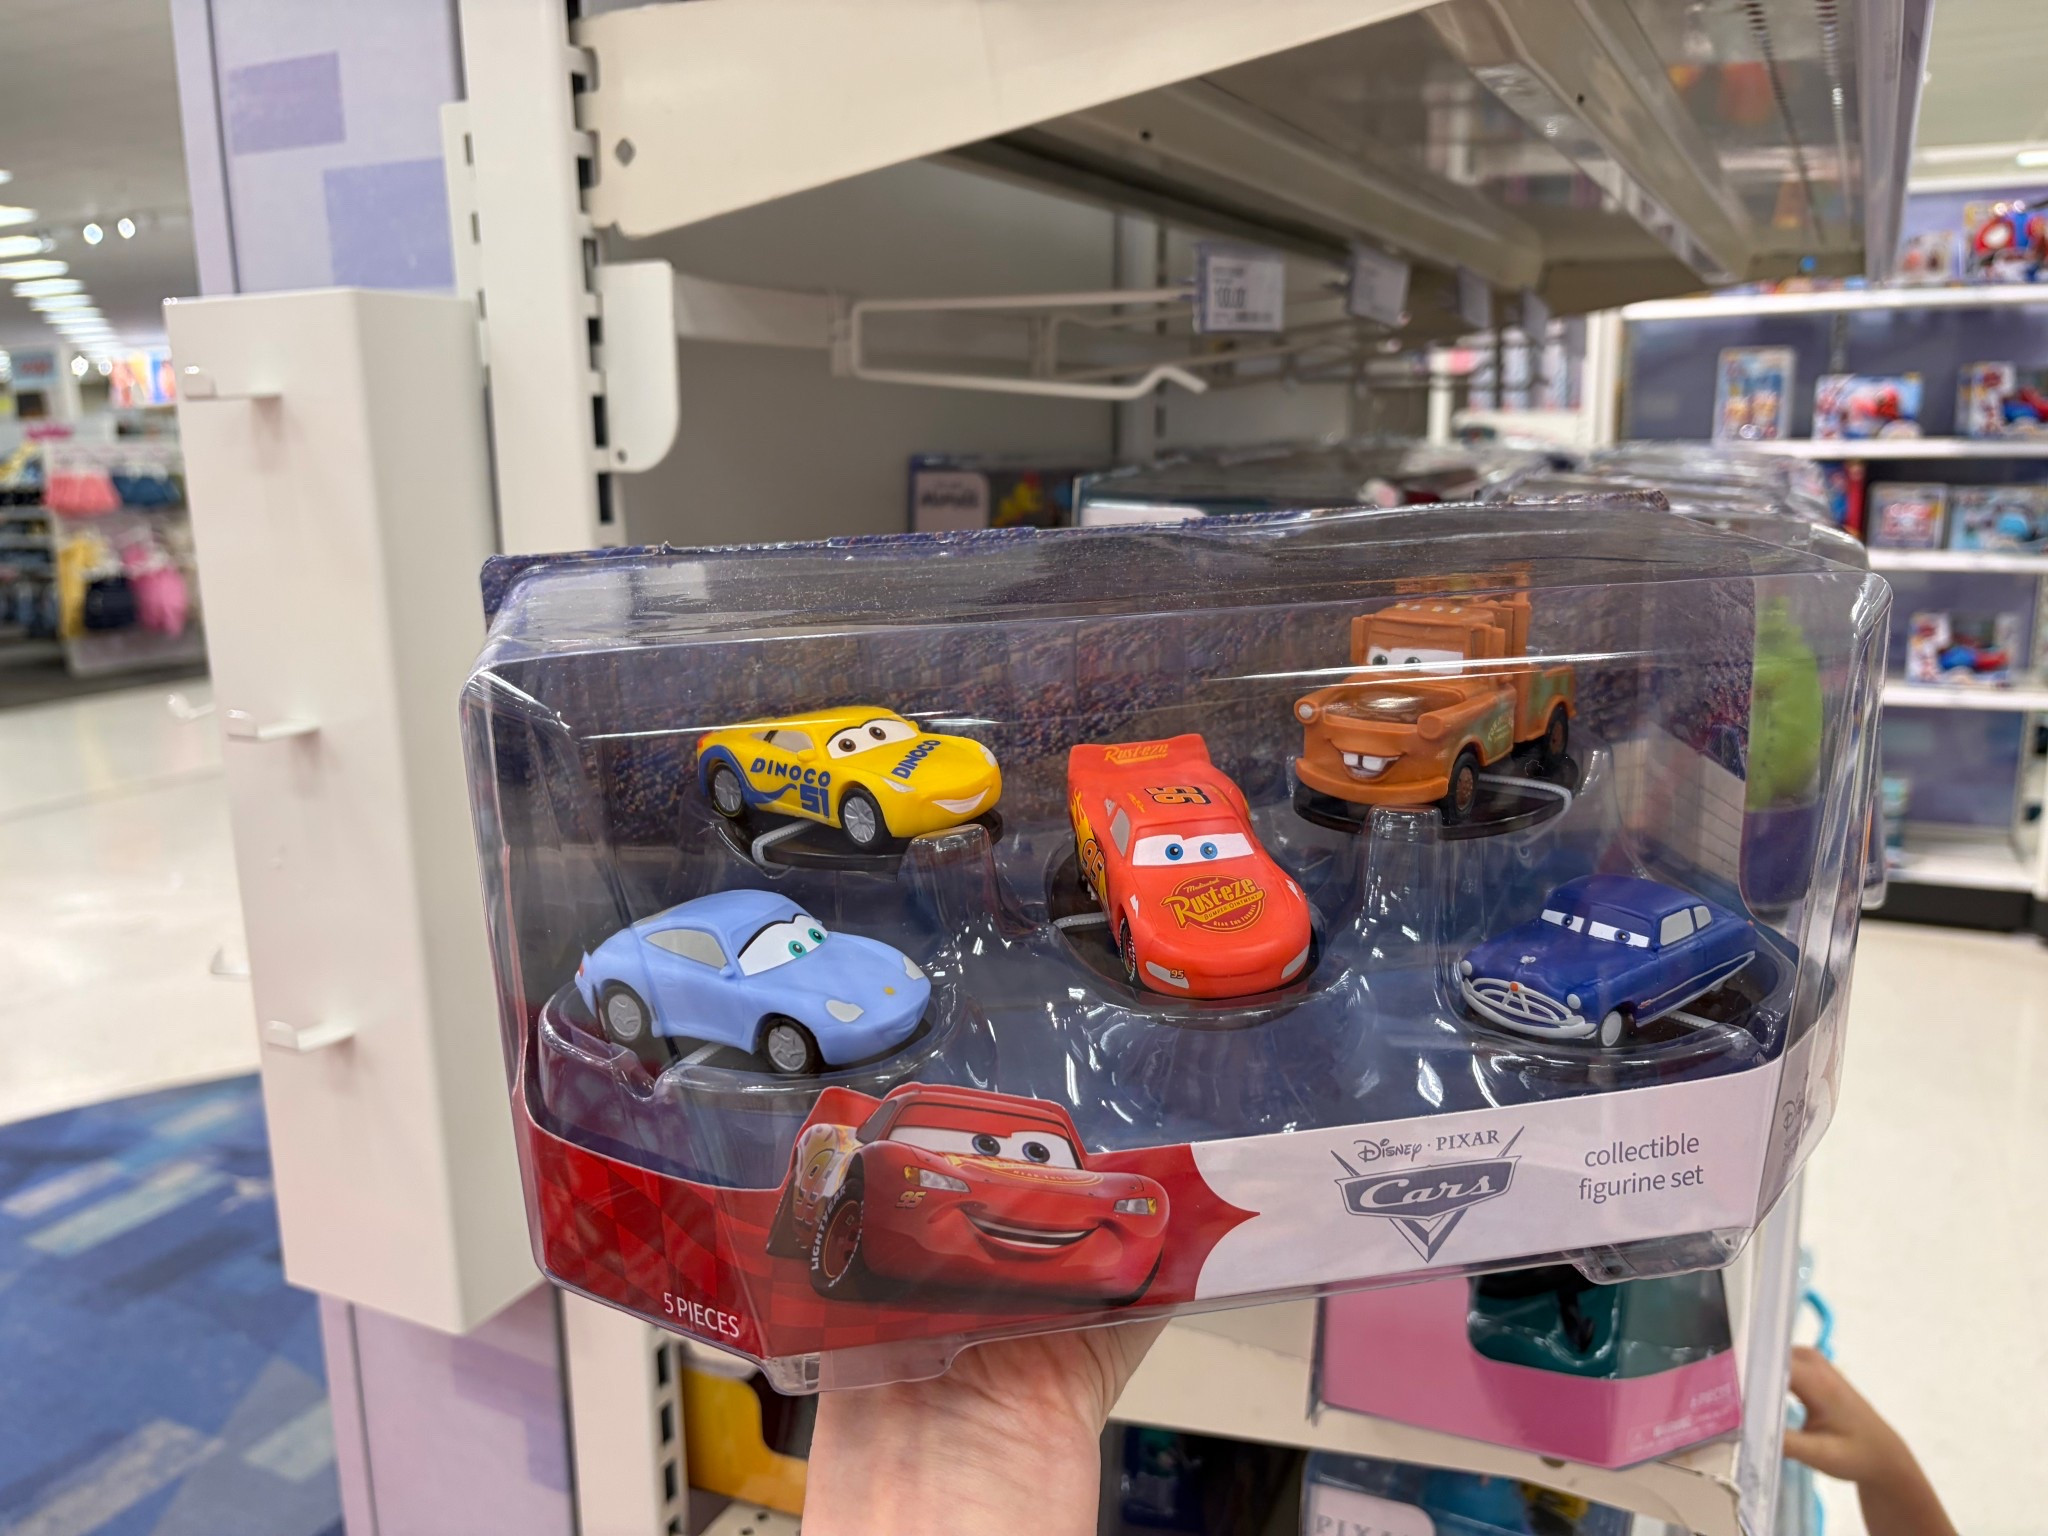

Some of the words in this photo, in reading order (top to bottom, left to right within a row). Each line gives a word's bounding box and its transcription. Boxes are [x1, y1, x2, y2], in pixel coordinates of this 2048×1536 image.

[750, 757, 831, 787] DINOCO
[891, 740, 941, 779] DINOCO
[800, 783, 830, 818] 51
[1144, 785, 1212, 805] 95
[1082, 838, 1106, 882] 95
[1170, 969, 1185, 979] 95
[1436, 1130, 1500, 1151] PIXAR
[1584, 1132, 1700, 1167] collectible
[895, 1191, 927, 1209] 95
[1359, 1175, 1497, 1208] Cars
[1579, 1172, 1666, 1204] figurine
[1671, 1165, 1704, 1188] set
[663, 1292, 674, 1314] 5
[676, 1296, 740, 1338] PIECES
